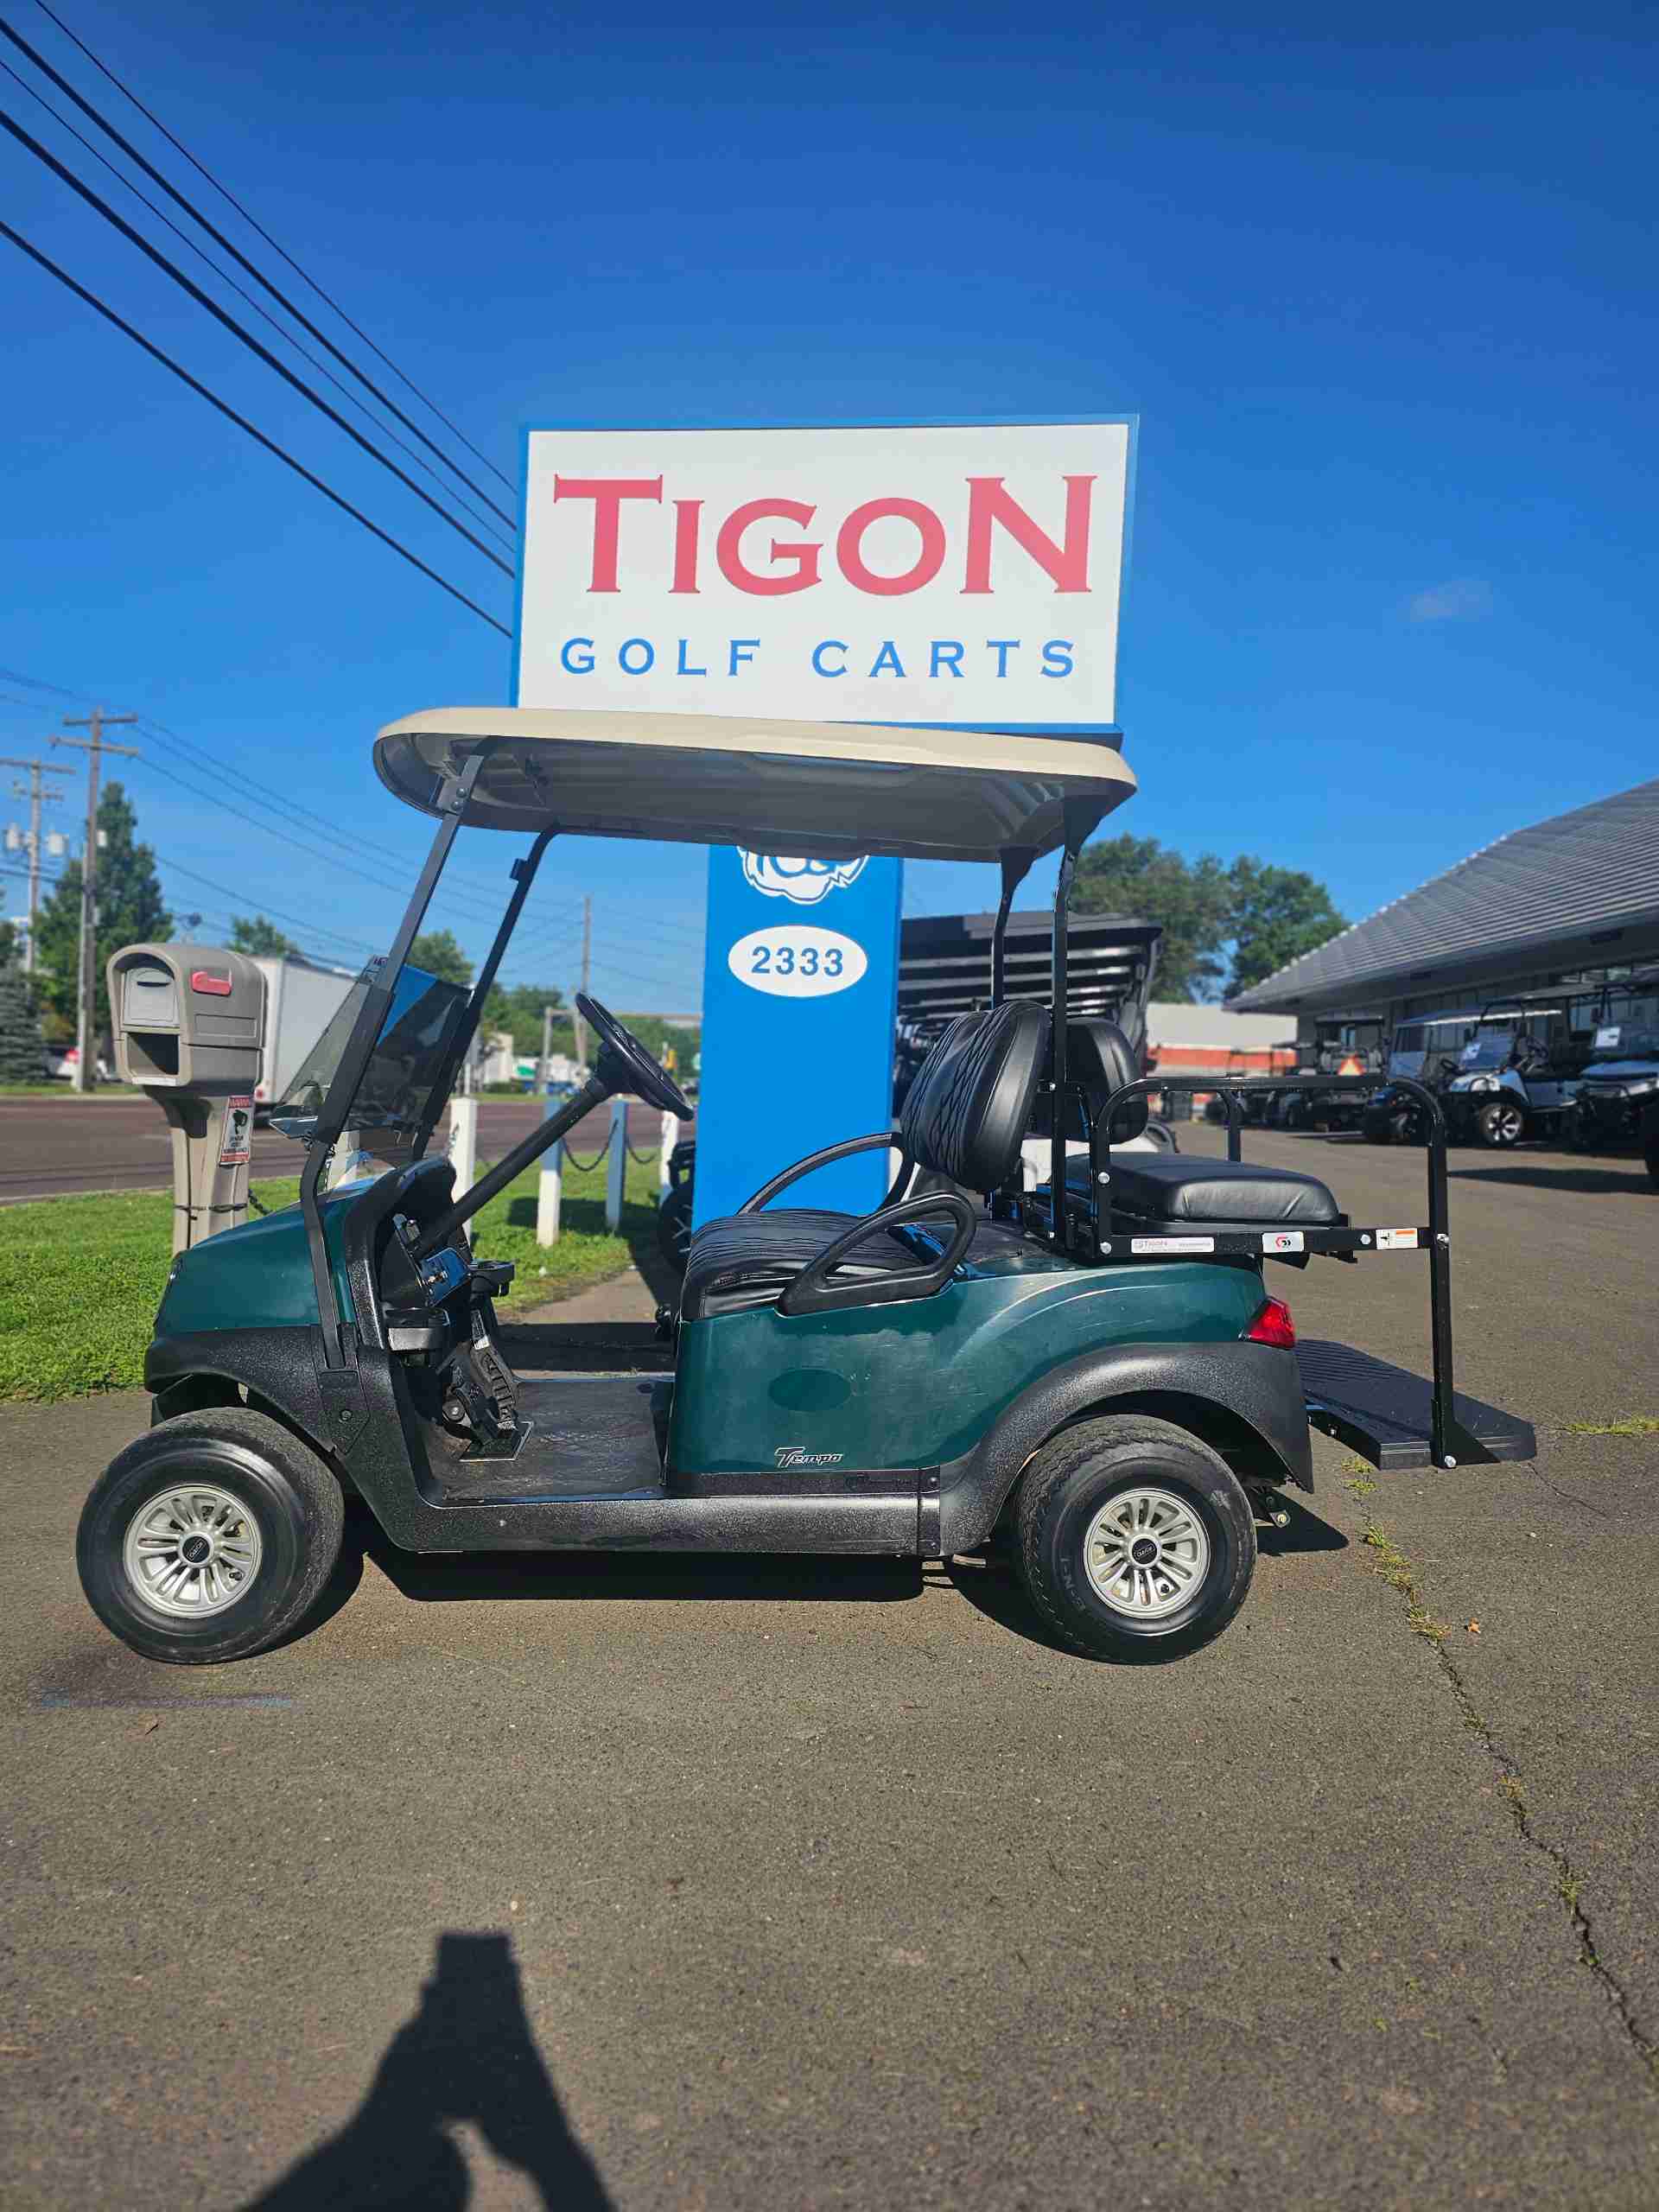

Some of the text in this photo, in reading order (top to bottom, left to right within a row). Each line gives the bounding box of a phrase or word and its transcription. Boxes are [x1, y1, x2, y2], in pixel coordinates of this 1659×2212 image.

[554, 474, 1097, 596] TIGON
[560, 637, 1075, 678] GOLF CARTS
[751, 946, 843, 977] 2333
[774, 1446, 843, 1468] Tempo
